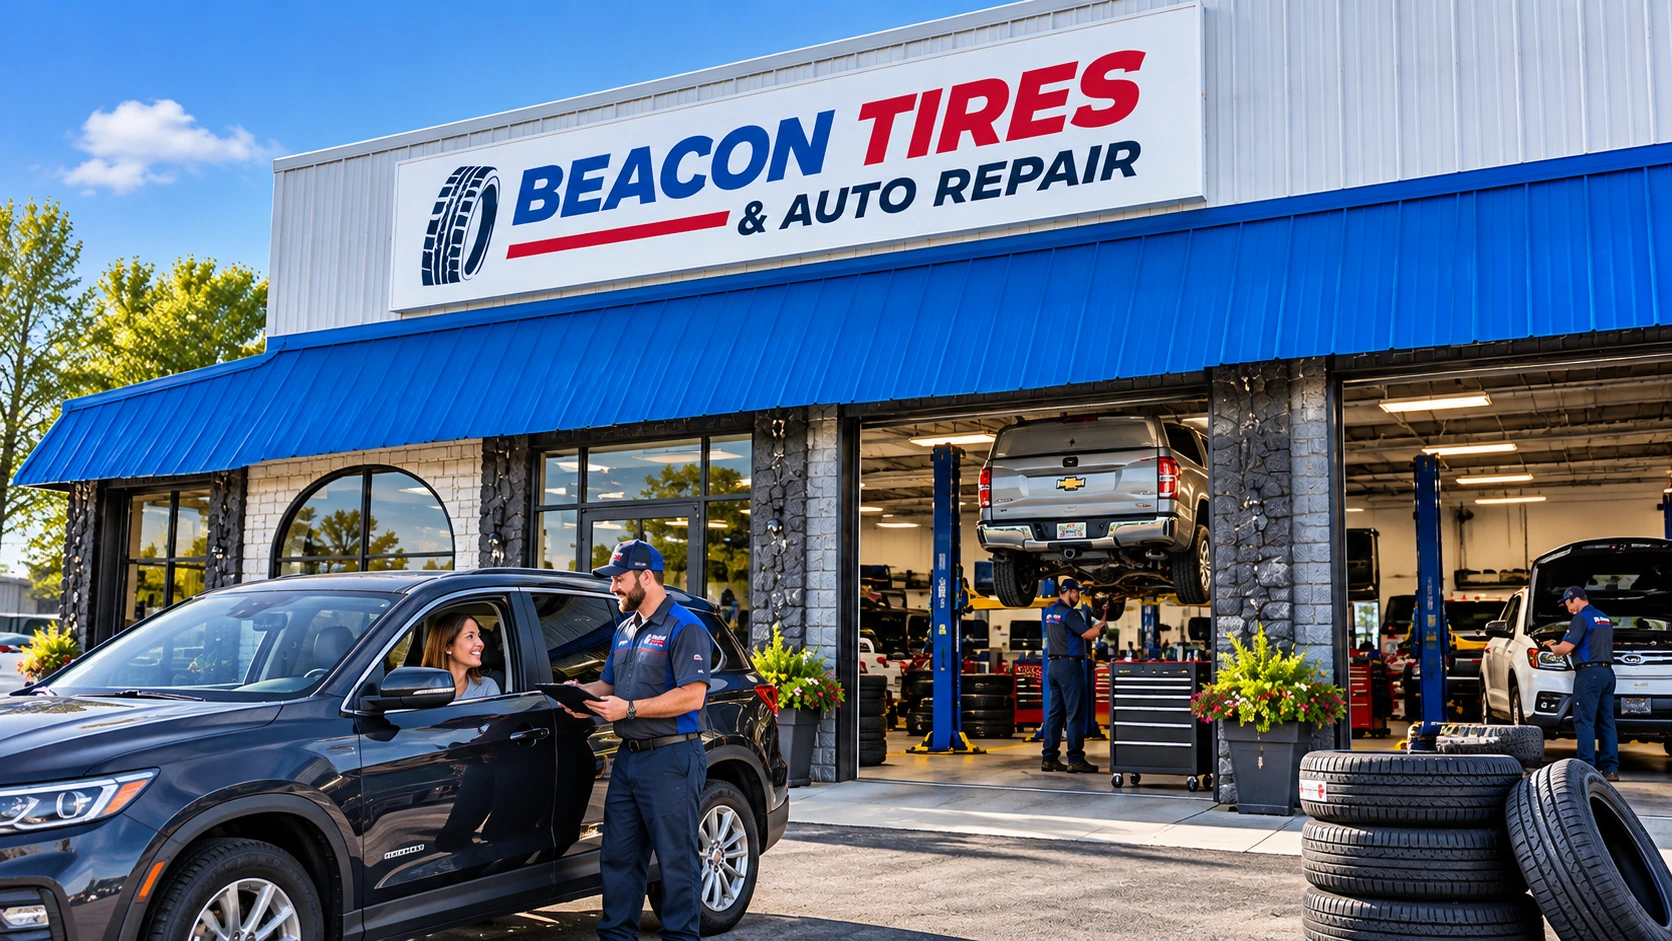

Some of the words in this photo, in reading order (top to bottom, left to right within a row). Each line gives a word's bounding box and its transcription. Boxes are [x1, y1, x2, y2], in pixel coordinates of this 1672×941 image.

[511, 109, 836, 226] BEACON
[857, 49, 1147, 166] TIRES
[737, 200, 768, 236] &
[778, 177, 917, 230] AUTO
[932, 140, 1142, 208] REPAIR
